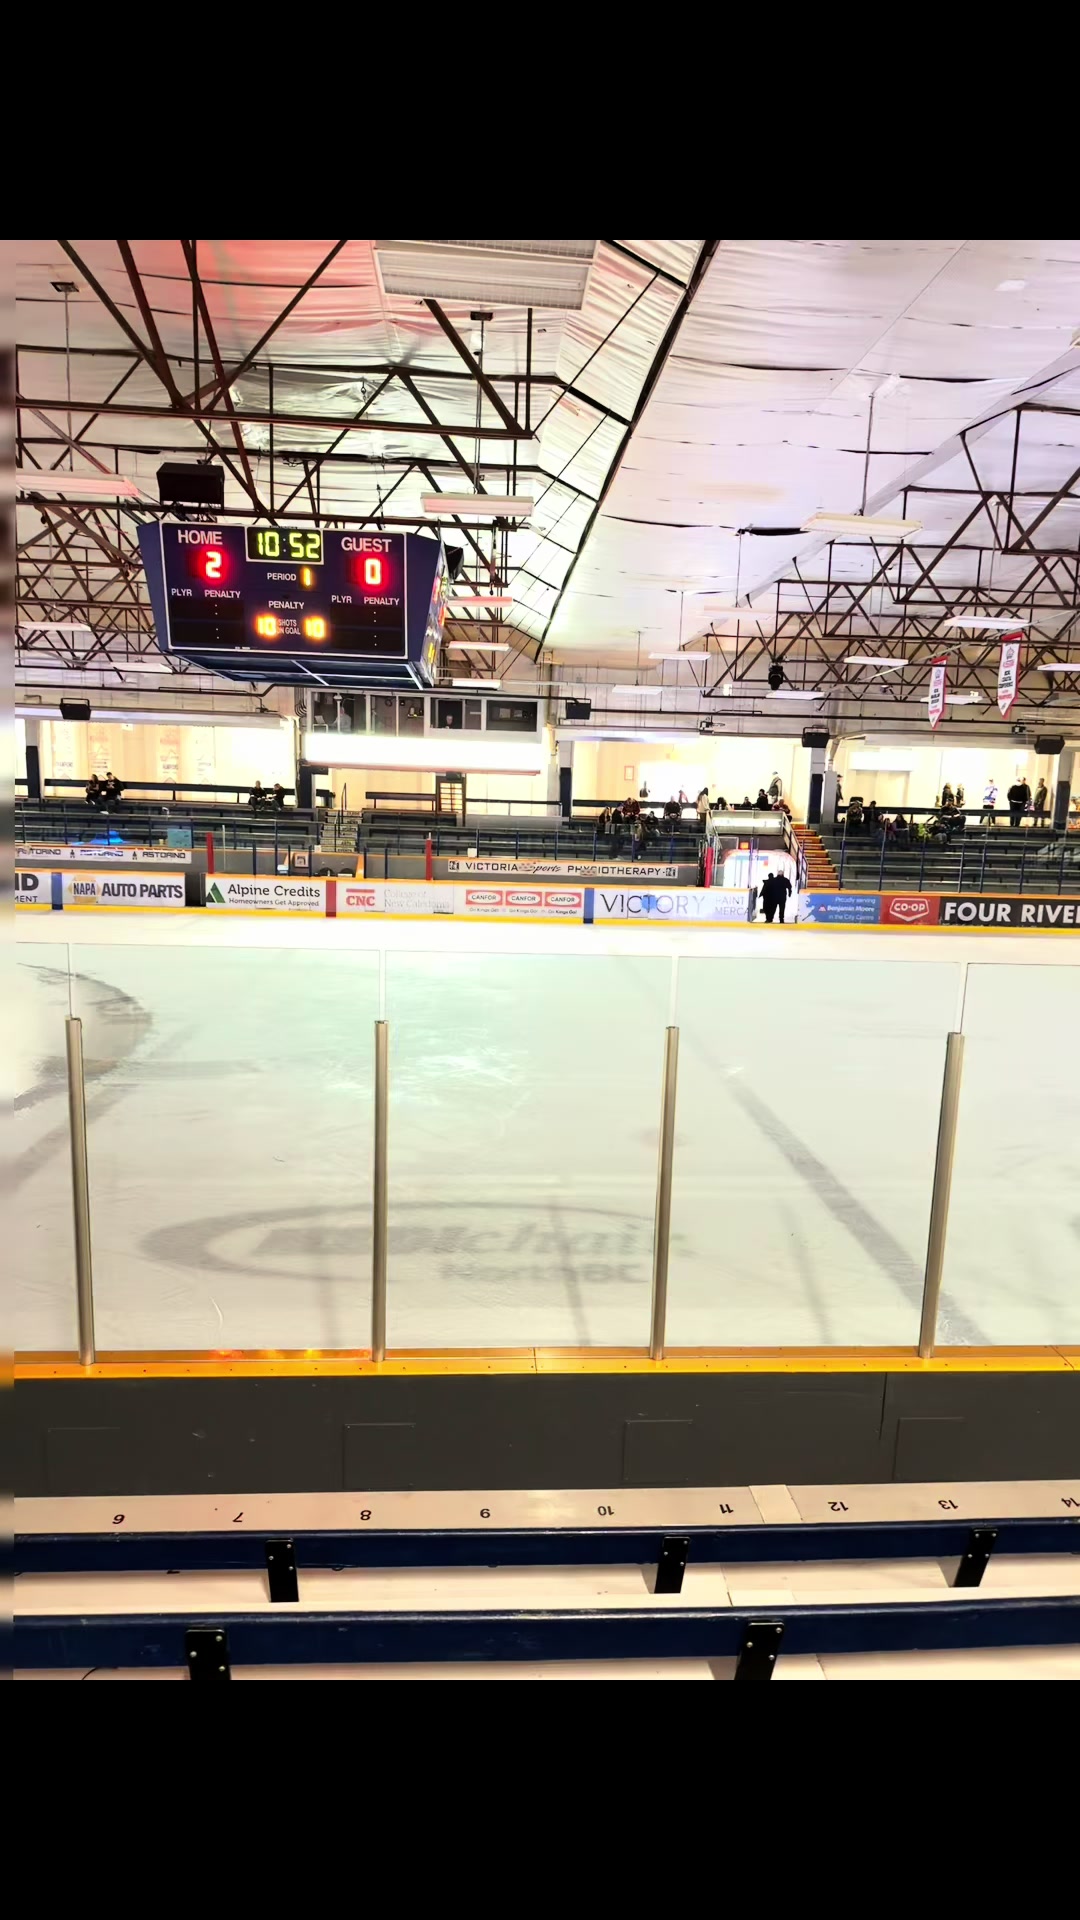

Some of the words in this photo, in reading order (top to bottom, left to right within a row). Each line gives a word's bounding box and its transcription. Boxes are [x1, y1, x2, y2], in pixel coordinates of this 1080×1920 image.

[177, 529, 223, 545] HOME
[257, 531, 321, 559] 10:52
[341, 536, 392, 553] GUEST
[205, 551, 222, 578] 2
[266, 572, 297, 581] PERIOD
[303, 567, 312, 587] 1
[365, 558, 382, 585] 0
[171, 588, 193, 597] PLYR
[204, 589, 241, 598] PENALTY
[268, 600, 305, 609] PENALTY
[331, 594, 352, 604] PLYR
[363, 596, 400, 606] PENALTY
[257, 615, 277, 636] 10
[278, 618, 297, 627] SHOTS
[305, 617, 325, 638] 10
[284, 626, 301, 635] GOAL
[142, 851, 186, 859] ASTORINO
[465, 861, 519, 872] VICTORIA
[525, 861, 561, 874] ports
[15, 873, 39, 891] D
[73, 882, 96, 896] NAPA
[101, 882, 137, 898] AUTO
[139, 883, 183, 899] PARTS
[227, 883, 270, 897] Alpine
[273, 885, 321, 898] Credits
[228, 897, 274, 905] Homeowners
[274, 898, 287, 906] Get
[288, 899, 320, 907] Approved
[345, 895, 375, 907] CNC
[600, 893, 705, 914] VICTORY
[715, 896, 745, 905] PAINT
[835, 896, 855, 905] Proudly
[827, 905, 855, 913] Benjamin
[944, 902, 1012, 923] FOUR
[843, 913, 855, 921] City
[719, 1503, 734, 1514] 11
[828, 1501, 849, 1512] 12
[937, 1499, 959, 1510] 13
[1061, 1497, 1080, 1508] 14
[360, 1509, 372, 1521] 8
[597, 1505, 615, 1516] 10
[232, 1512, 244, 1523] 7
